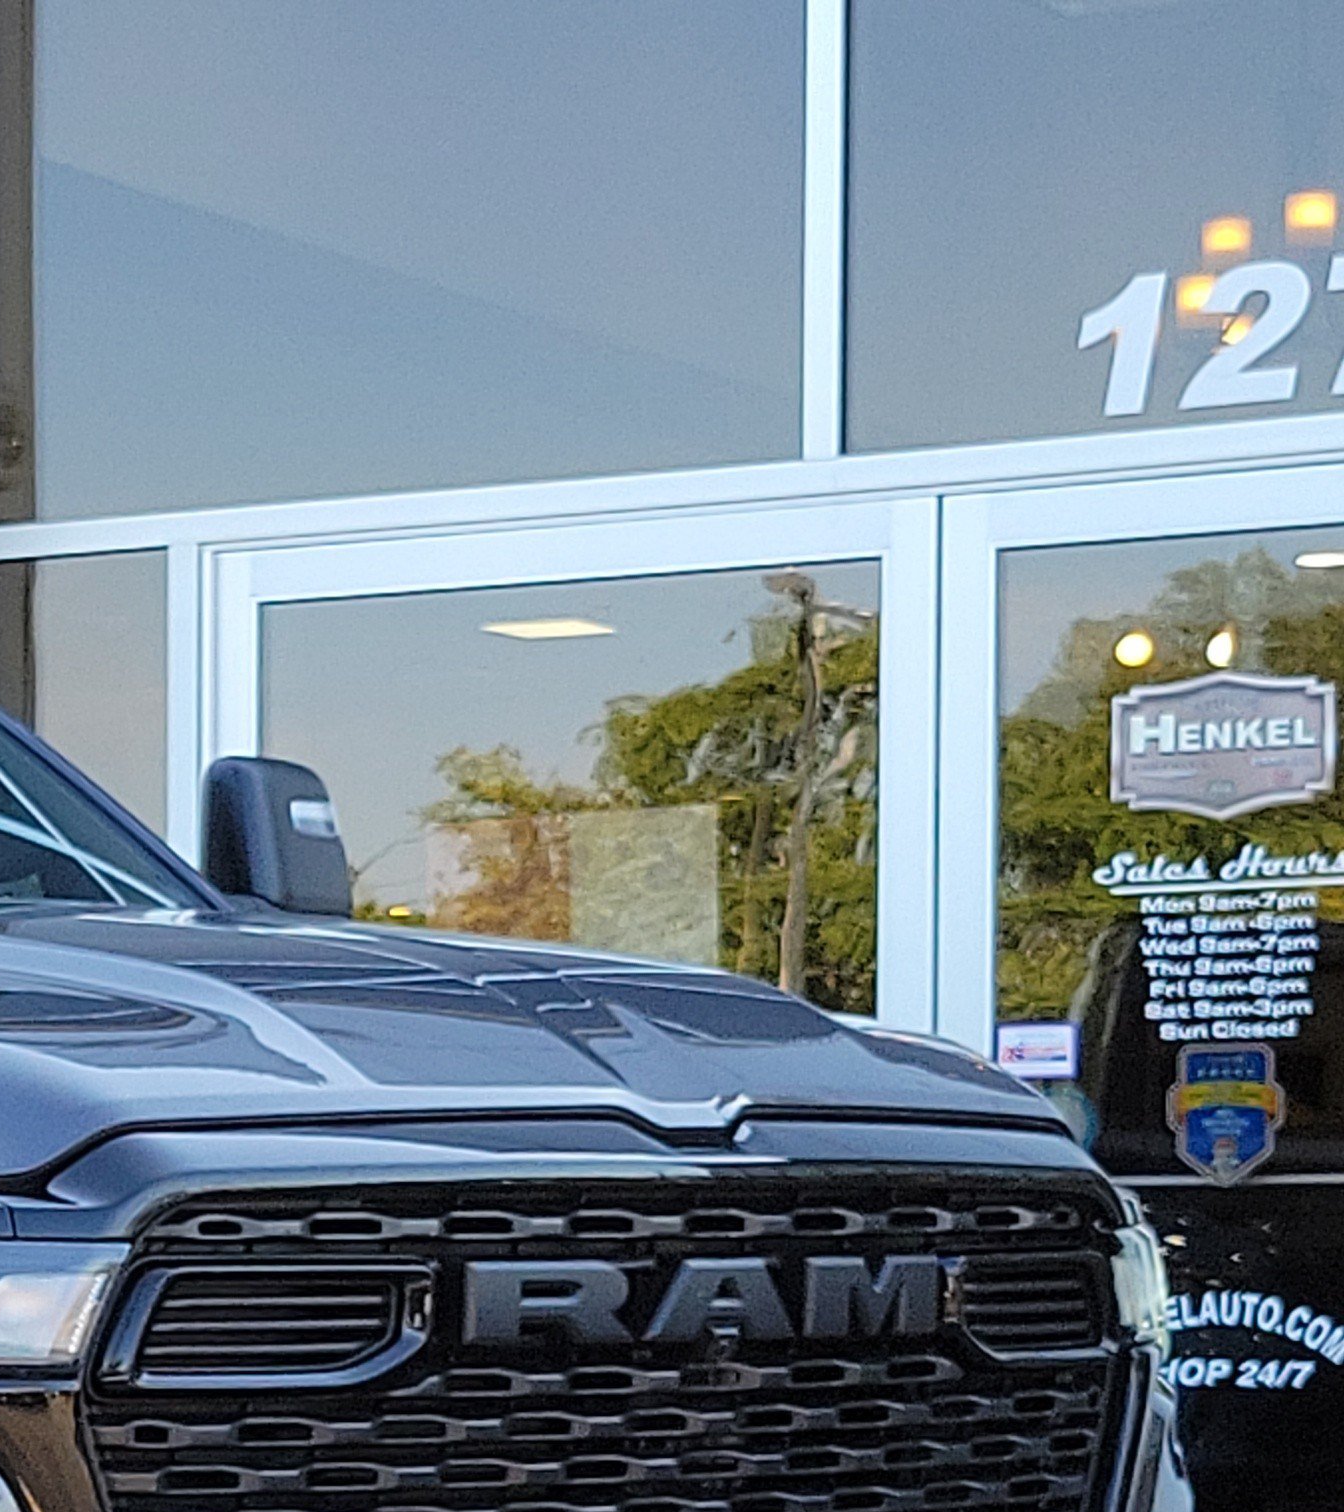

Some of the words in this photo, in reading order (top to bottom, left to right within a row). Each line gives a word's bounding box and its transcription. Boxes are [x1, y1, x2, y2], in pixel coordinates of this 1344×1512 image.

[1129, 714, 1316, 755] HENKEL
[1092, 851, 1211, 886] Sales
[1140, 896, 1196, 914] Mon
[1142, 916, 1188, 935] Tue
[1139, 936, 1197, 956] Wed
[1142, 958, 1192, 977] Thu
[1149, 979, 1187, 998] Fri
[1144, 1000, 1192, 1020] Sat
[1159, 1022, 1209, 1041] Sun
[1211, 1018, 1300, 1039] Closed
[463, 1257, 939, 1345] RAM
[1234, 1359, 1316, 1389] 24/7
